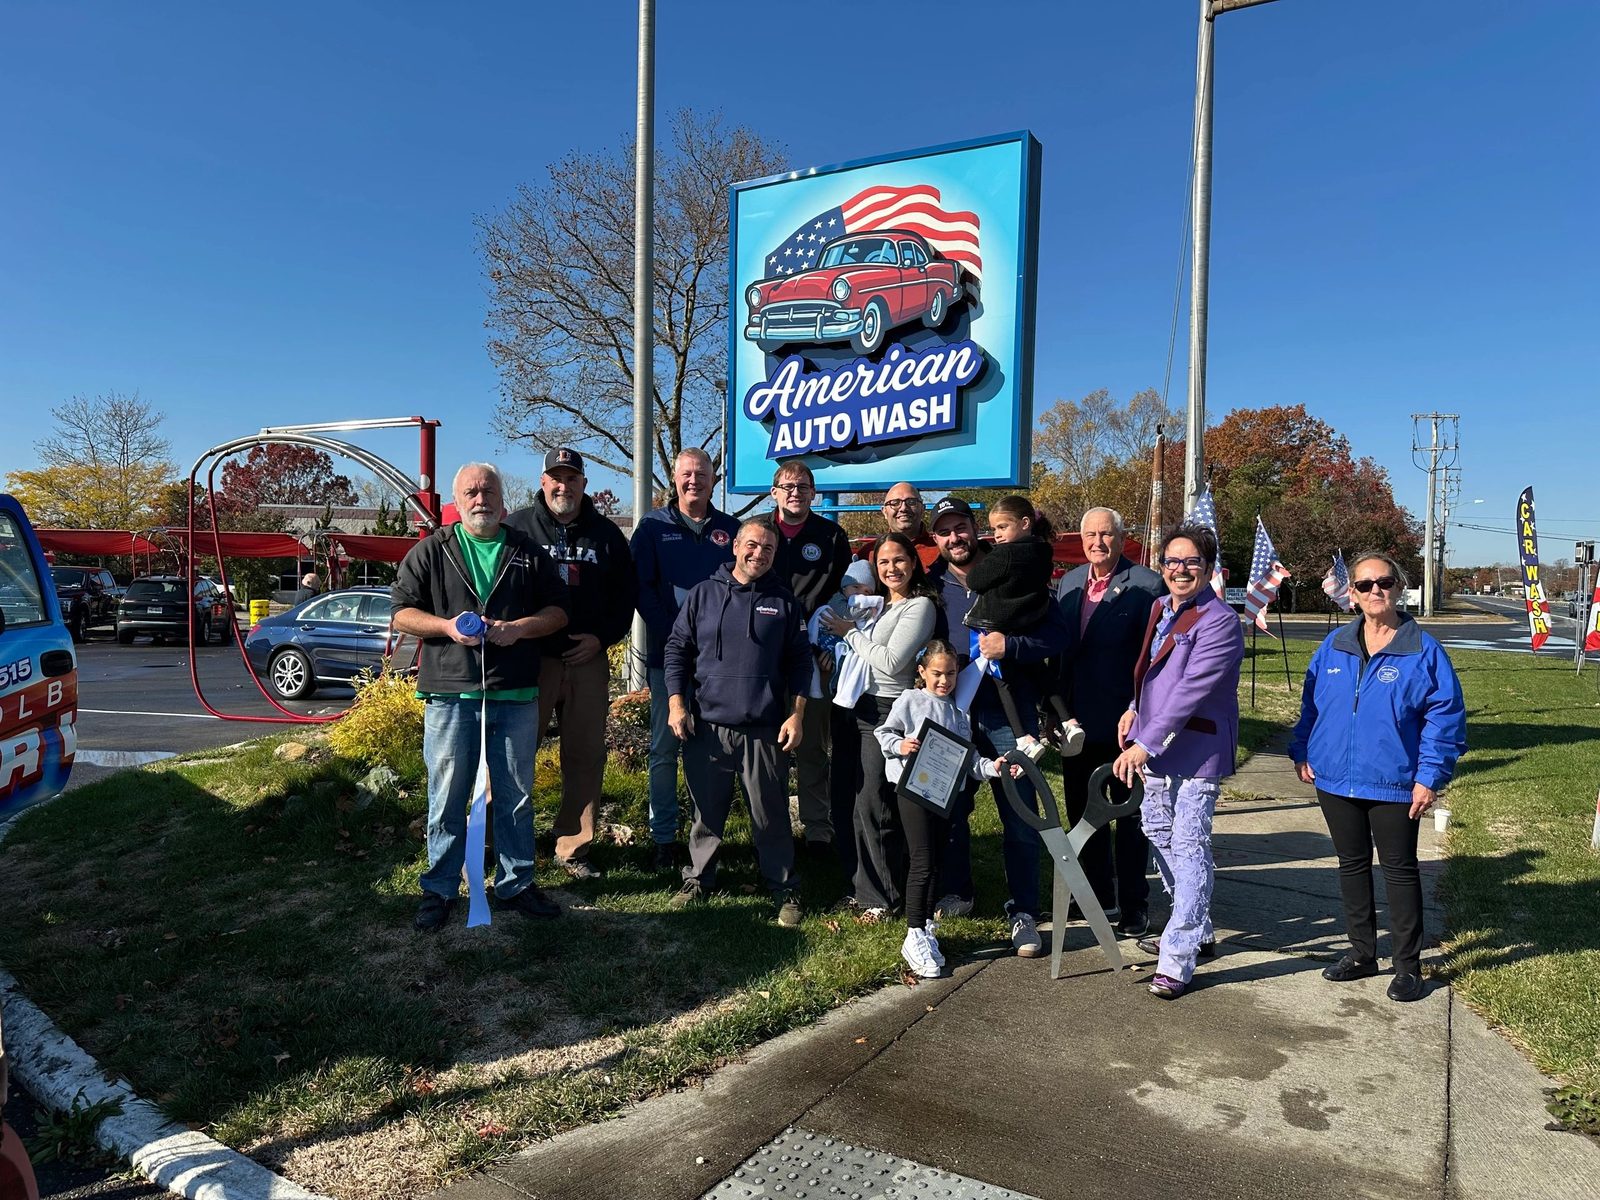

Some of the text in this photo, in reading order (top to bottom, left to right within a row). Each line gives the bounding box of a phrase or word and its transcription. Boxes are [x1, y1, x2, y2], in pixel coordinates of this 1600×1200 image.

[749, 347, 977, 417] American
[774, 393, 951, 452] AUTO WASH
[1520, 502, 1548, 634] CAR WASH
